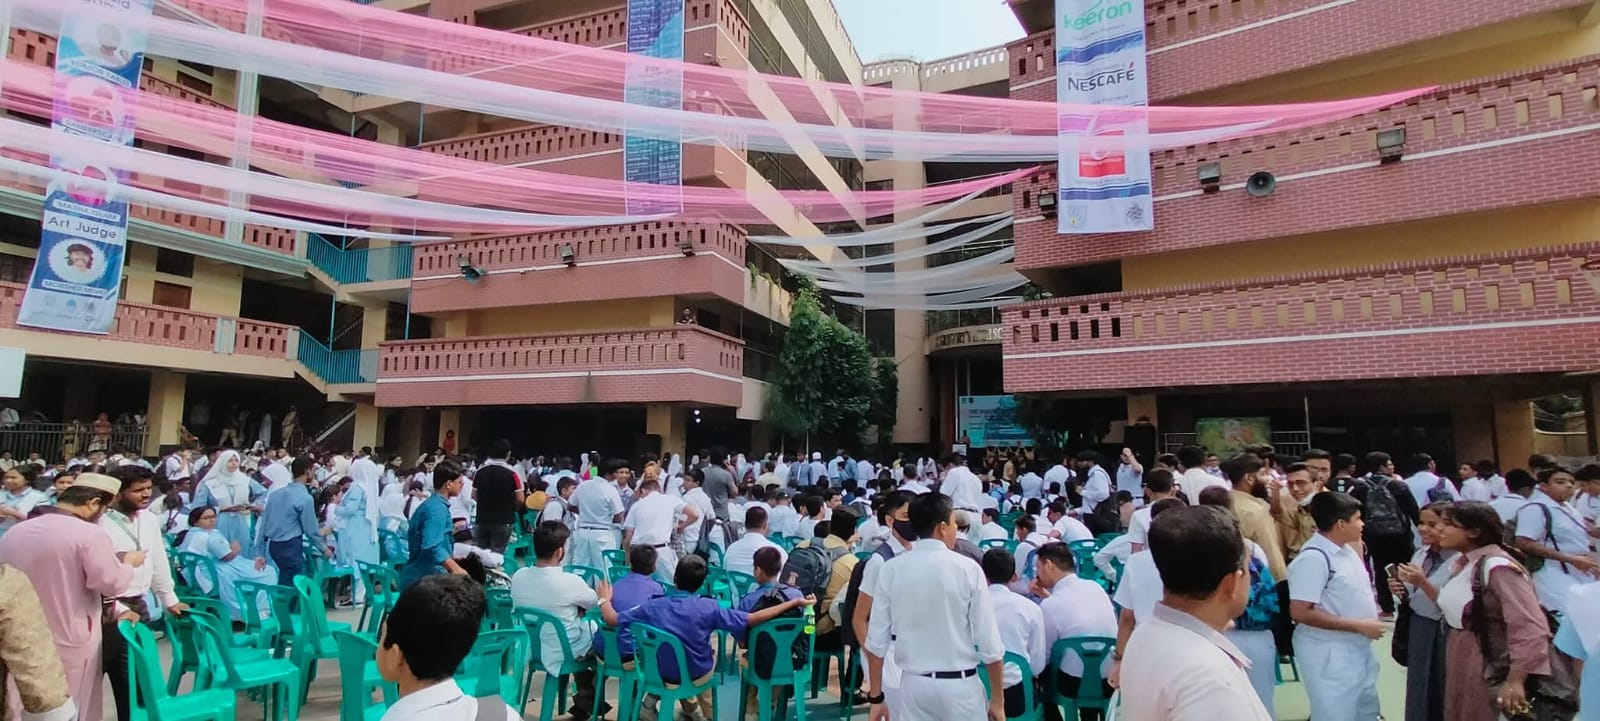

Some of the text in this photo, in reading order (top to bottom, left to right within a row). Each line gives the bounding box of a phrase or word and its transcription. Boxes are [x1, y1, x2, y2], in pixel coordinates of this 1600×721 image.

[1067, 61, 1135, 92] NESCAFÉ
[48, 216, 117, 239] Art Judge
